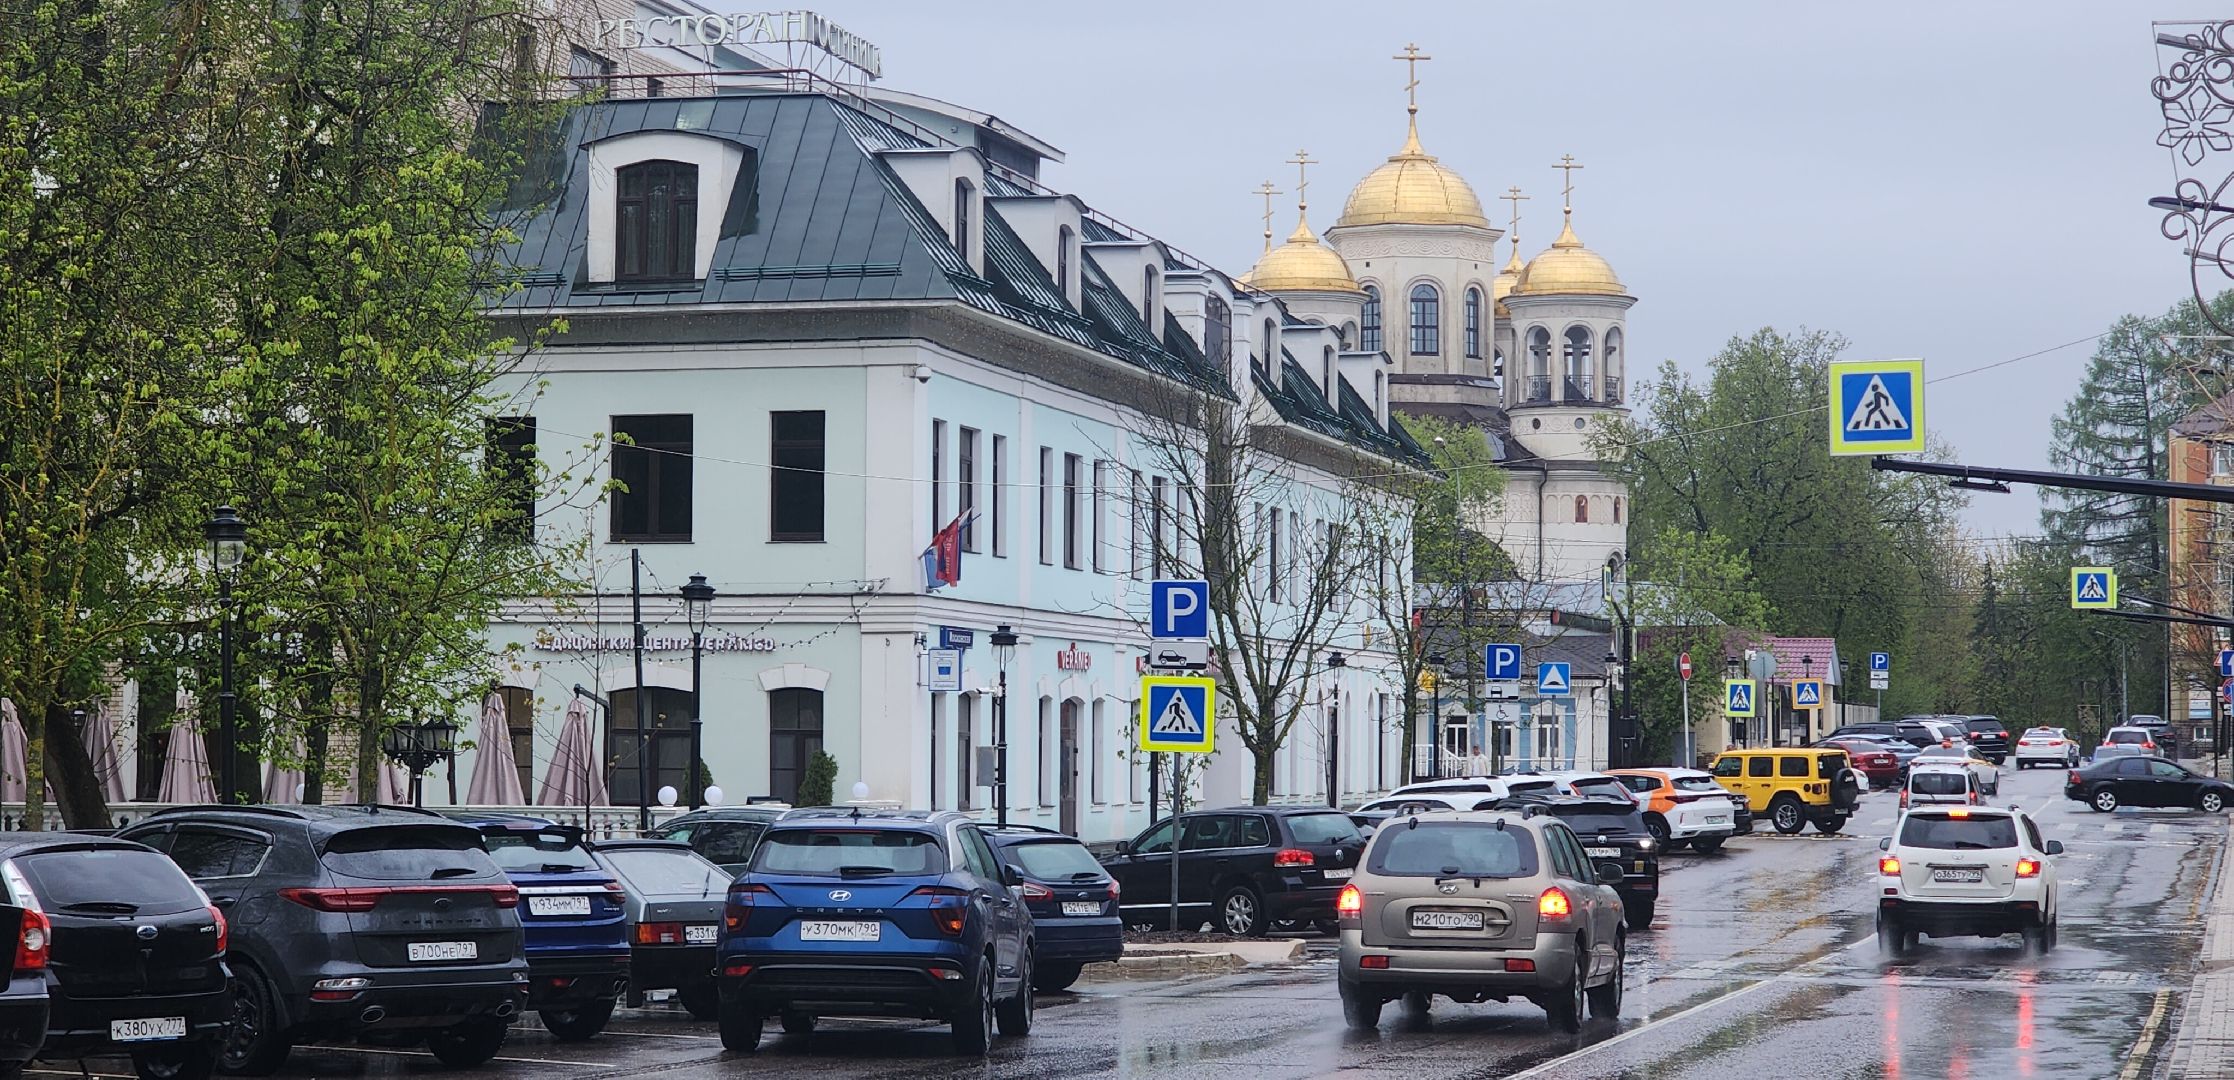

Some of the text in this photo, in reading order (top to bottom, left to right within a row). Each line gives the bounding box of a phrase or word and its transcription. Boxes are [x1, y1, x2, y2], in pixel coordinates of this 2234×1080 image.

[594, 10, 810, 50] РЕСТОРАН
[1167, 587, 1198, 632] P
[643, 635, 690, 653] ЦЕНТР
[1495, 647, 1515, 676] P
[1875, 654, 1886, 669] P
